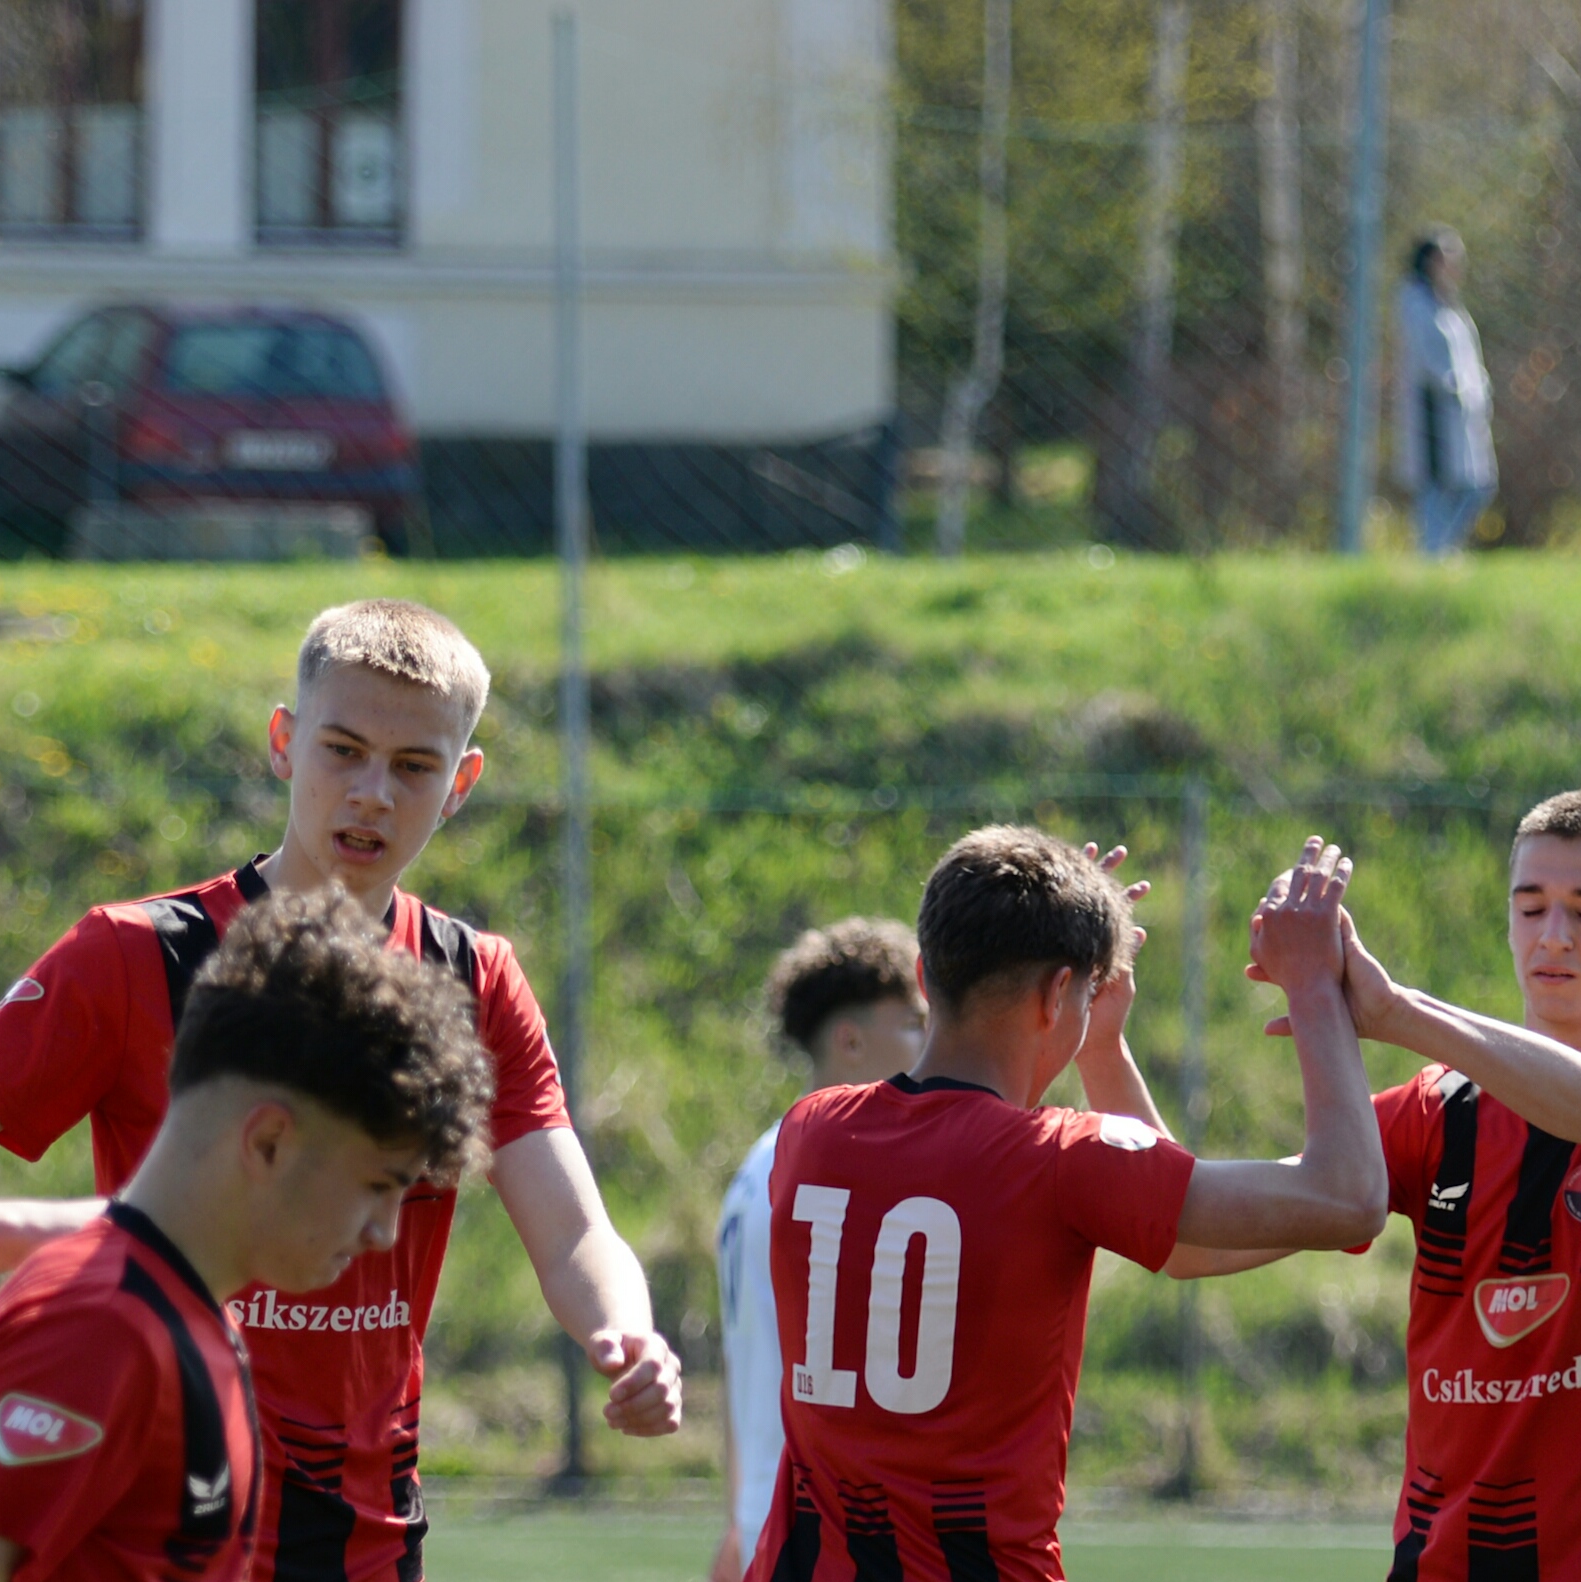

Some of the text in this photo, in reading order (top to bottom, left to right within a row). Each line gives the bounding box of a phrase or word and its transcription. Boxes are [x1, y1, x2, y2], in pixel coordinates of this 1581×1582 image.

[225, 1289, 411, 1332] síkszereda
[792, 1184, 962, 1414] 10
[1488, 1286, 1538, 1313] MOL
[797, 1372, 813, 1396] U16
[4, 1405, 65, 1443] MOL
